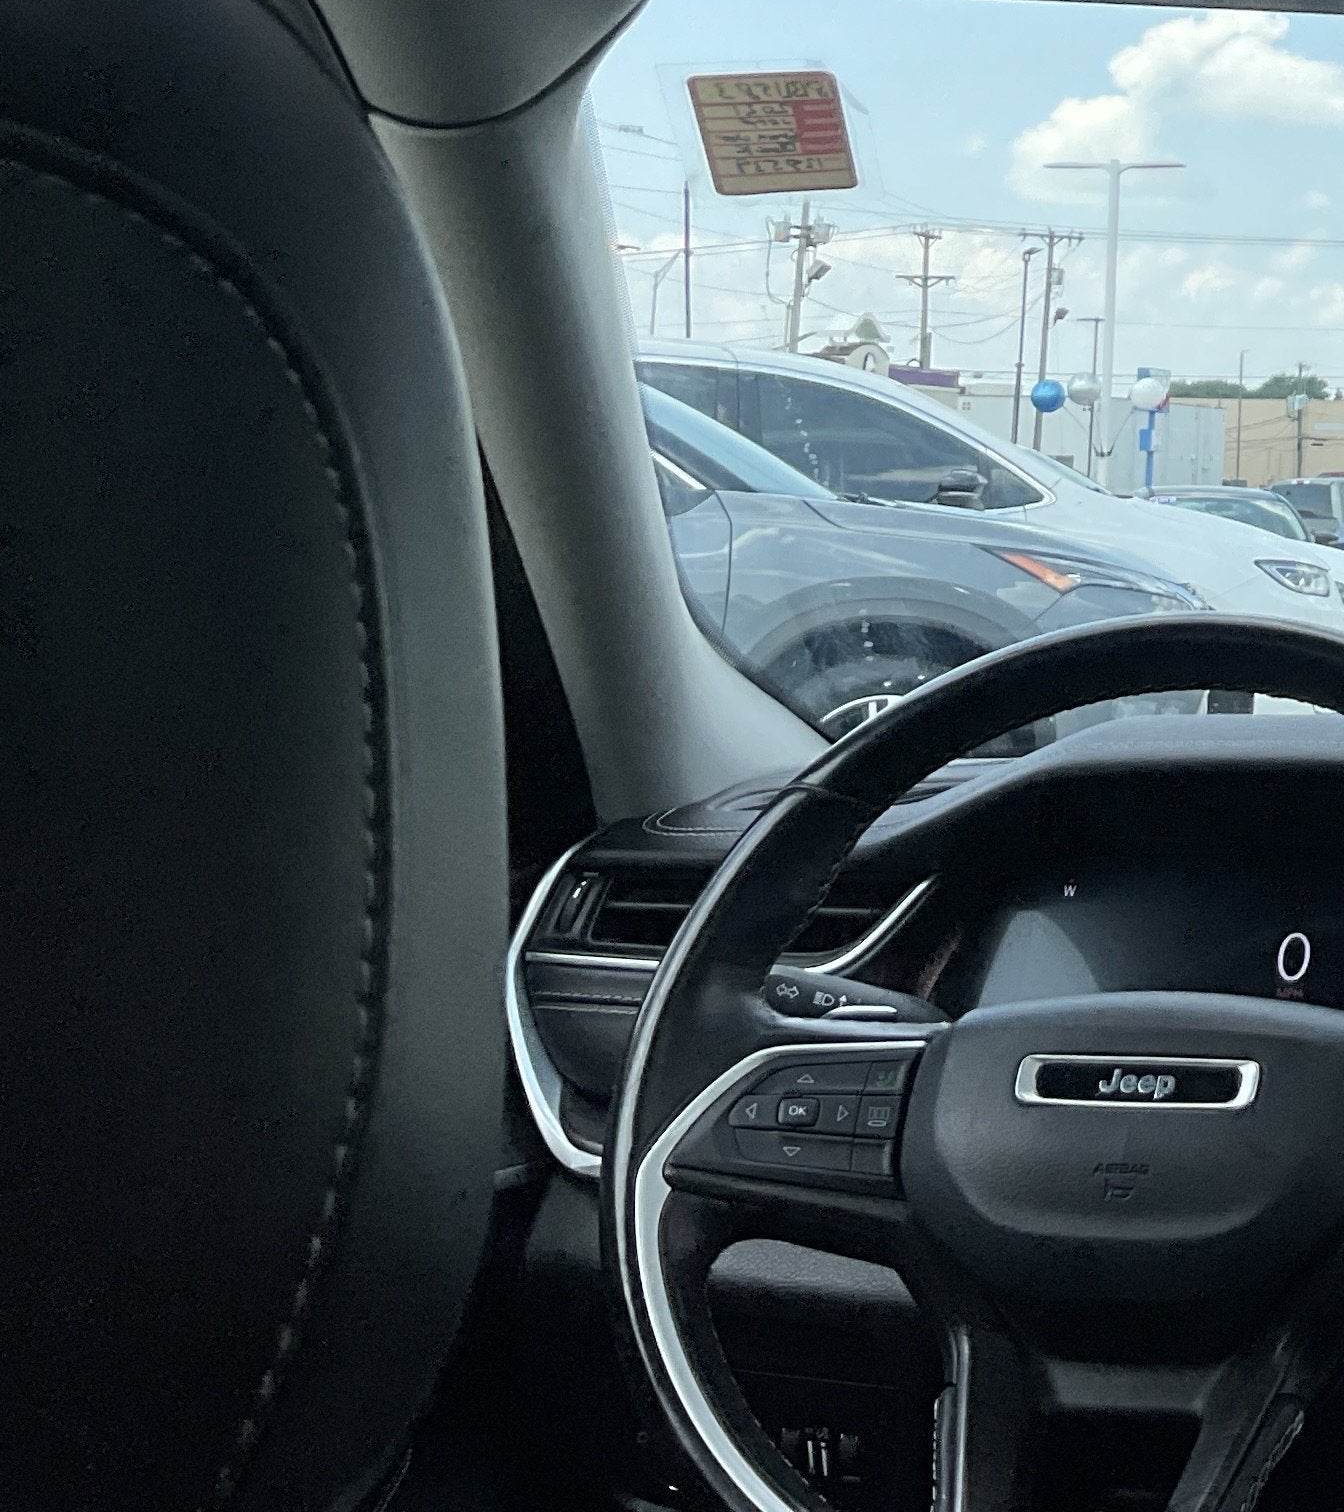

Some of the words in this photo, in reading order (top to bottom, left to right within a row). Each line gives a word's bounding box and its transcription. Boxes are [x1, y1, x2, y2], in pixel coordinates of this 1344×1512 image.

[1278, 932, 1311, 981] 0
[1098, 1068, 1176, 1100] Jeep
[788, 1105, 807, 1116] OK
